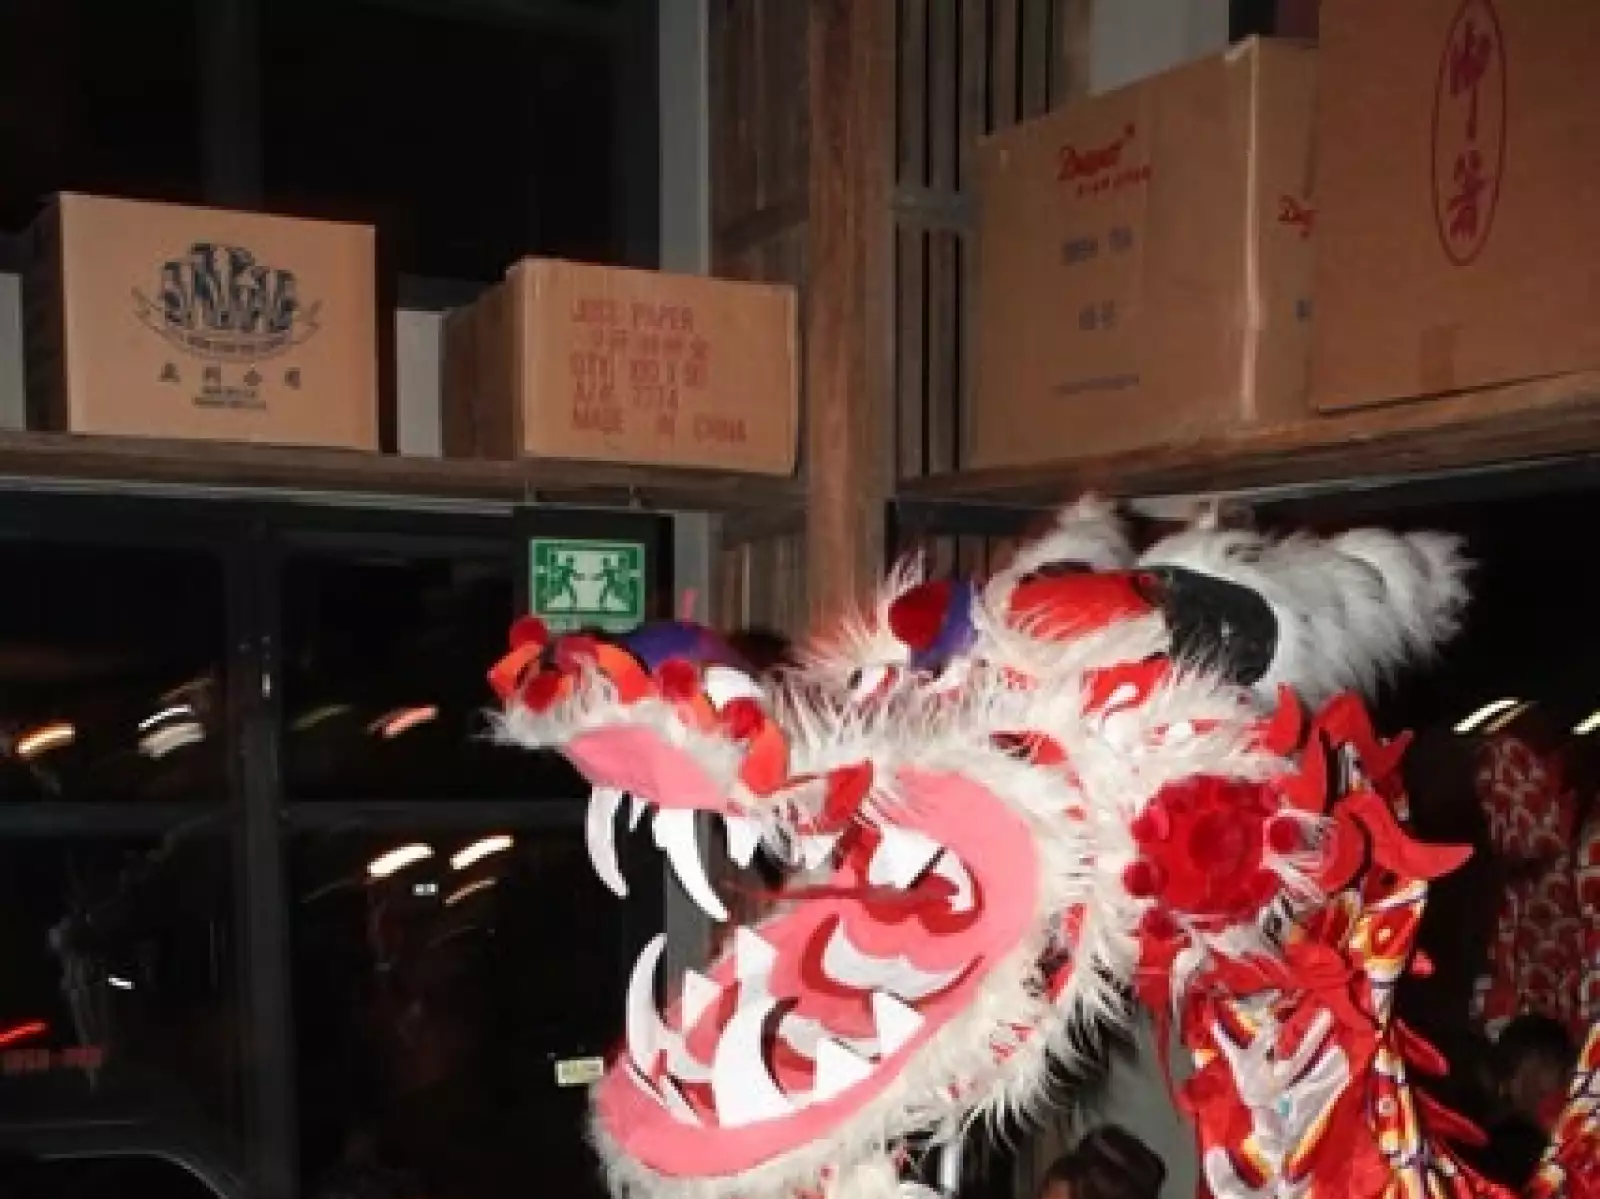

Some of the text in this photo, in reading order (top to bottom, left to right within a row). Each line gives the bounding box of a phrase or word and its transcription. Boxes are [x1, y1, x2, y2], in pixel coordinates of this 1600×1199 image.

[630, 302, 694, 331] PAPER
[571, 404, 625, 434] MADE
[693, 413, 748, 443] CHINA
